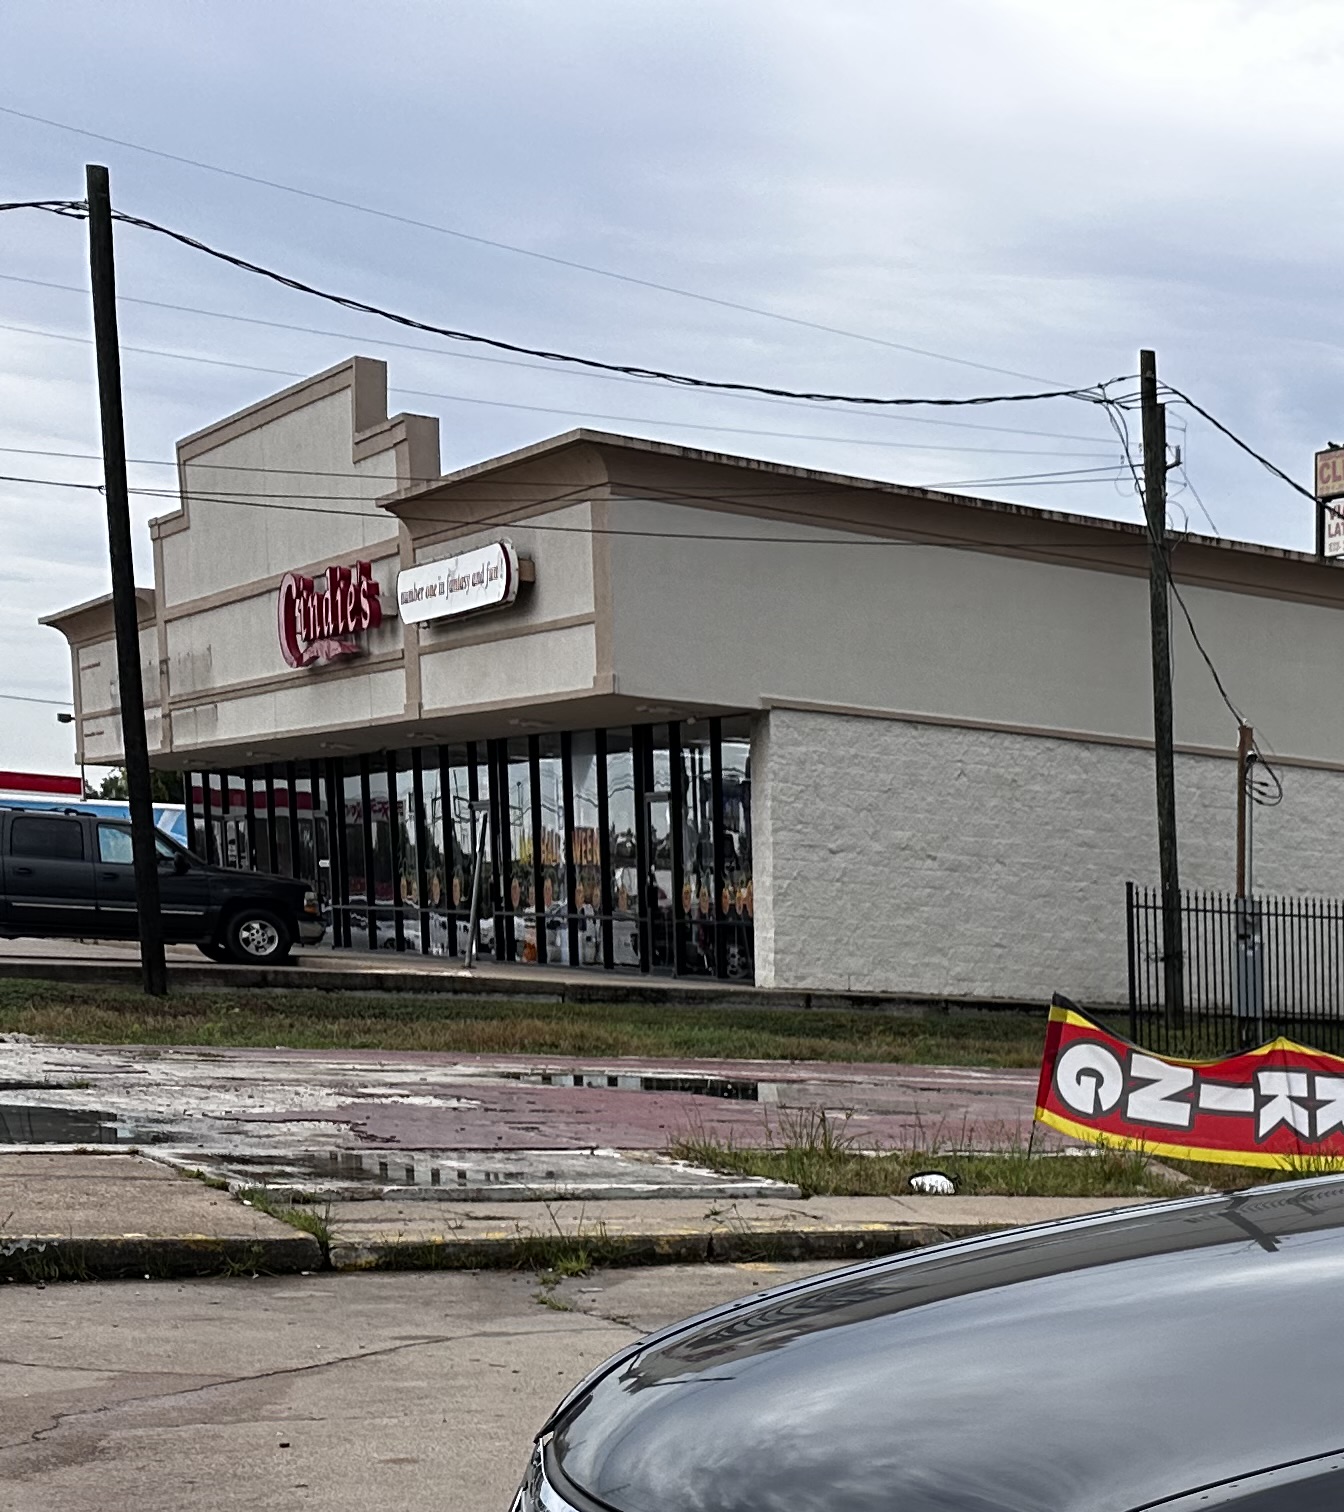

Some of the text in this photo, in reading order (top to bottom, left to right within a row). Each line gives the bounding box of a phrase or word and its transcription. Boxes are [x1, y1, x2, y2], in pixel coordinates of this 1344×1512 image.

[278, 560, 381, 667] Cindie's
[400, 581, 424, 605] number
[425, 583, 437, 599] one
[438, 575, 445, 596] in
[446, 573, 471, 600] fantasy
[472, 562, 485, 587] and
